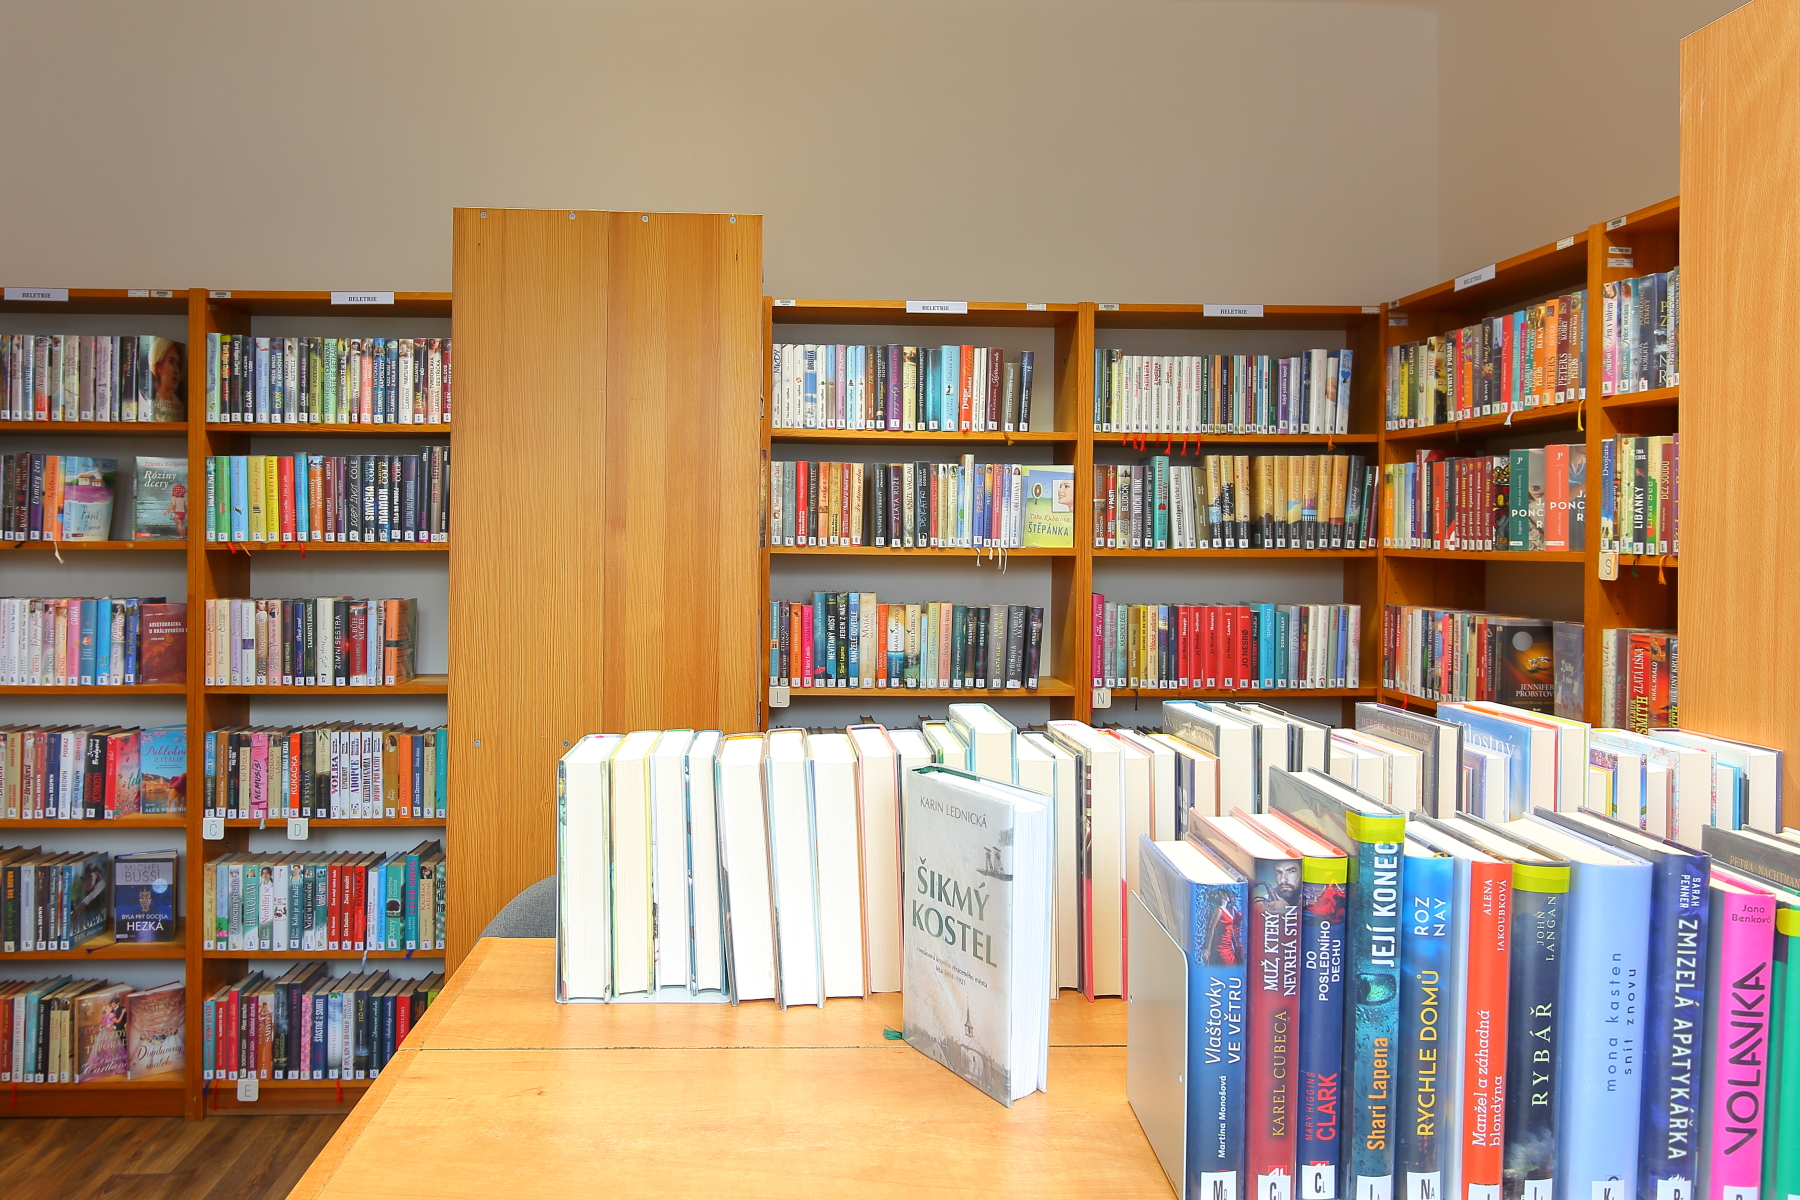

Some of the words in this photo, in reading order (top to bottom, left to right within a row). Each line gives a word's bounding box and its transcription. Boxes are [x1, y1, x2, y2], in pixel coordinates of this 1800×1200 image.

[1462, 274, 1482, 286] BELETRIE
[773, 349, 781, 374] NIKDY
[1546, 356, 1556, 390] PETERS
[1558, 352, 1568, 386] PETERS
[144, 470, 177, 482] Róziny
[1602, 444, 1611, 476] Dvojčata
[144, 479, 170, 491] dcery
[363, 485, 375, 521] SMYČKA
[378, 488, 388, 525] MAMON
[1028, 520, 1070, 538] ŠTĚPÁNKA
[350, 618, 358, 632] BŮH
[838, 604, 846, 615] NÁS
[850, 610, 858, 636] ODVEDLE
[826, 632, 836, 660] NEVÍTANÝ
[849, 636, 858, 663] MANŽELÉ
[1241, 629, 1249, 657] NESBØ
[1632, 648, 1644, 670] LIŠKA
[1241, 657, 1249, 668] JO
[776, 690, 782, 704] L
[1097, 692, 1105, 705] N
[1631, 670, 1644, 694] ZLATÁ
[1636, 695, 1648, 734] SMITH
[252, 760, 262, 801] NEMUSÍŠ!
[350, 759, 359, 794] ADOPCE
[294, 823, 302, 837] D
[920, 796, 944, 814] KARIN
[946, 804, 988, 828] LEDNICKÁ
[125, 871, 160, 882] BUSSI
[408, 860, 417, 887] MNOU
[1373, 840, 1398, 918] KONEC
[1730, 855, 1754, 872] PETRA
[246, 882, 256, 926] HLAVOLAM
[354, 870, 364, 906] RIVALKA
[408, 888, 417, 899] SE
[917, 856, 990, 922] ŠIKMÝ
[1482, 878, 1492, 915] ALENA
[1680, 874, 1689, 909] PENNER
[1691, 877, 1700, 907] SARAH
[127, 918, 164, 931] HEZKÁ
[261, 894, 271, 923] Neohlížej
[408, 900, 417, 914] LŽI
[1285, 905, 1298, 942] STÍN
[1414, 896, 1430, 936] ROZ
[1433, 897, 1447, 937] NAY
[1496, 880, 1507, 952] JAKOUBKOVÁ
[1742, 904, 1765, 914] Jana
[912, 898, 998, 968] KOSTEL
[1263, 910, 1279, 953] KTERÝ
[1372, 924, 1396, 967] JEJÍ
[1536, 910, 1545, 946] JOHN
[1546, 895, 1556, 962] LANGAN
[1264, 957, 1279, 992] MUŽ,
[1284, 946, 1296, 996] NEVRHÁ
[1306, 951, 1317, 970] DO
[1318, 920, 1331, 1001] POSLEDNÍHO
[1331, 938, 1341, 983] DECHU
[1674, 919, 1699, 1008] ZMIZELÁ
[1228, 976, 1242, 1032] VĚTRU
[1420, 970, 1439, 1042] DOMŮ
[1606, 952, 1623, 1024] kasten
[1626, 969, 1637, 1026] znovu
[1205, 976, 1226, 1065] Vlaštovky
[1228, 1039, 1241, 1064] VE
[1274, 1010, 1287, 1090] CUBECA
[1476, 1010, 1491, 1073] záhadná
[1529, 1002, 1552, 1107] RYBÁŘ
[1624, 1039, 1633, 1075] snít
[1724, 961, 1768, 1156] VOLANKA
[1368, 1037, 1390, 1098] Lapena
[1606, 1037, 1617, 1092] mona
[244, 1084, 252, 1098] E
[1217, 1075, 1227, 1114] Monošová
[1306, 1072, 1315, 1112] HIGGINS
[1418, 1049, 1437, 1136] RYCHLE
[1479, 1079, 1488, 1088] a
[1667, 1017, 1694, 1161] APATYKÁŘKA
[1272, 1096, 1285, 1137] KAREL
[1316, 1073, 1337, 1141] CLARK
[1472, 1091, 1488, 1146] Manžel
[1489, 1075, 1503, 1147] blondýna
[1217, 1116, 1226, 1158] Martina
[1305, 1115, 1314, 1141] MARY
[1367, 1103, 1385, 1150] Shari
